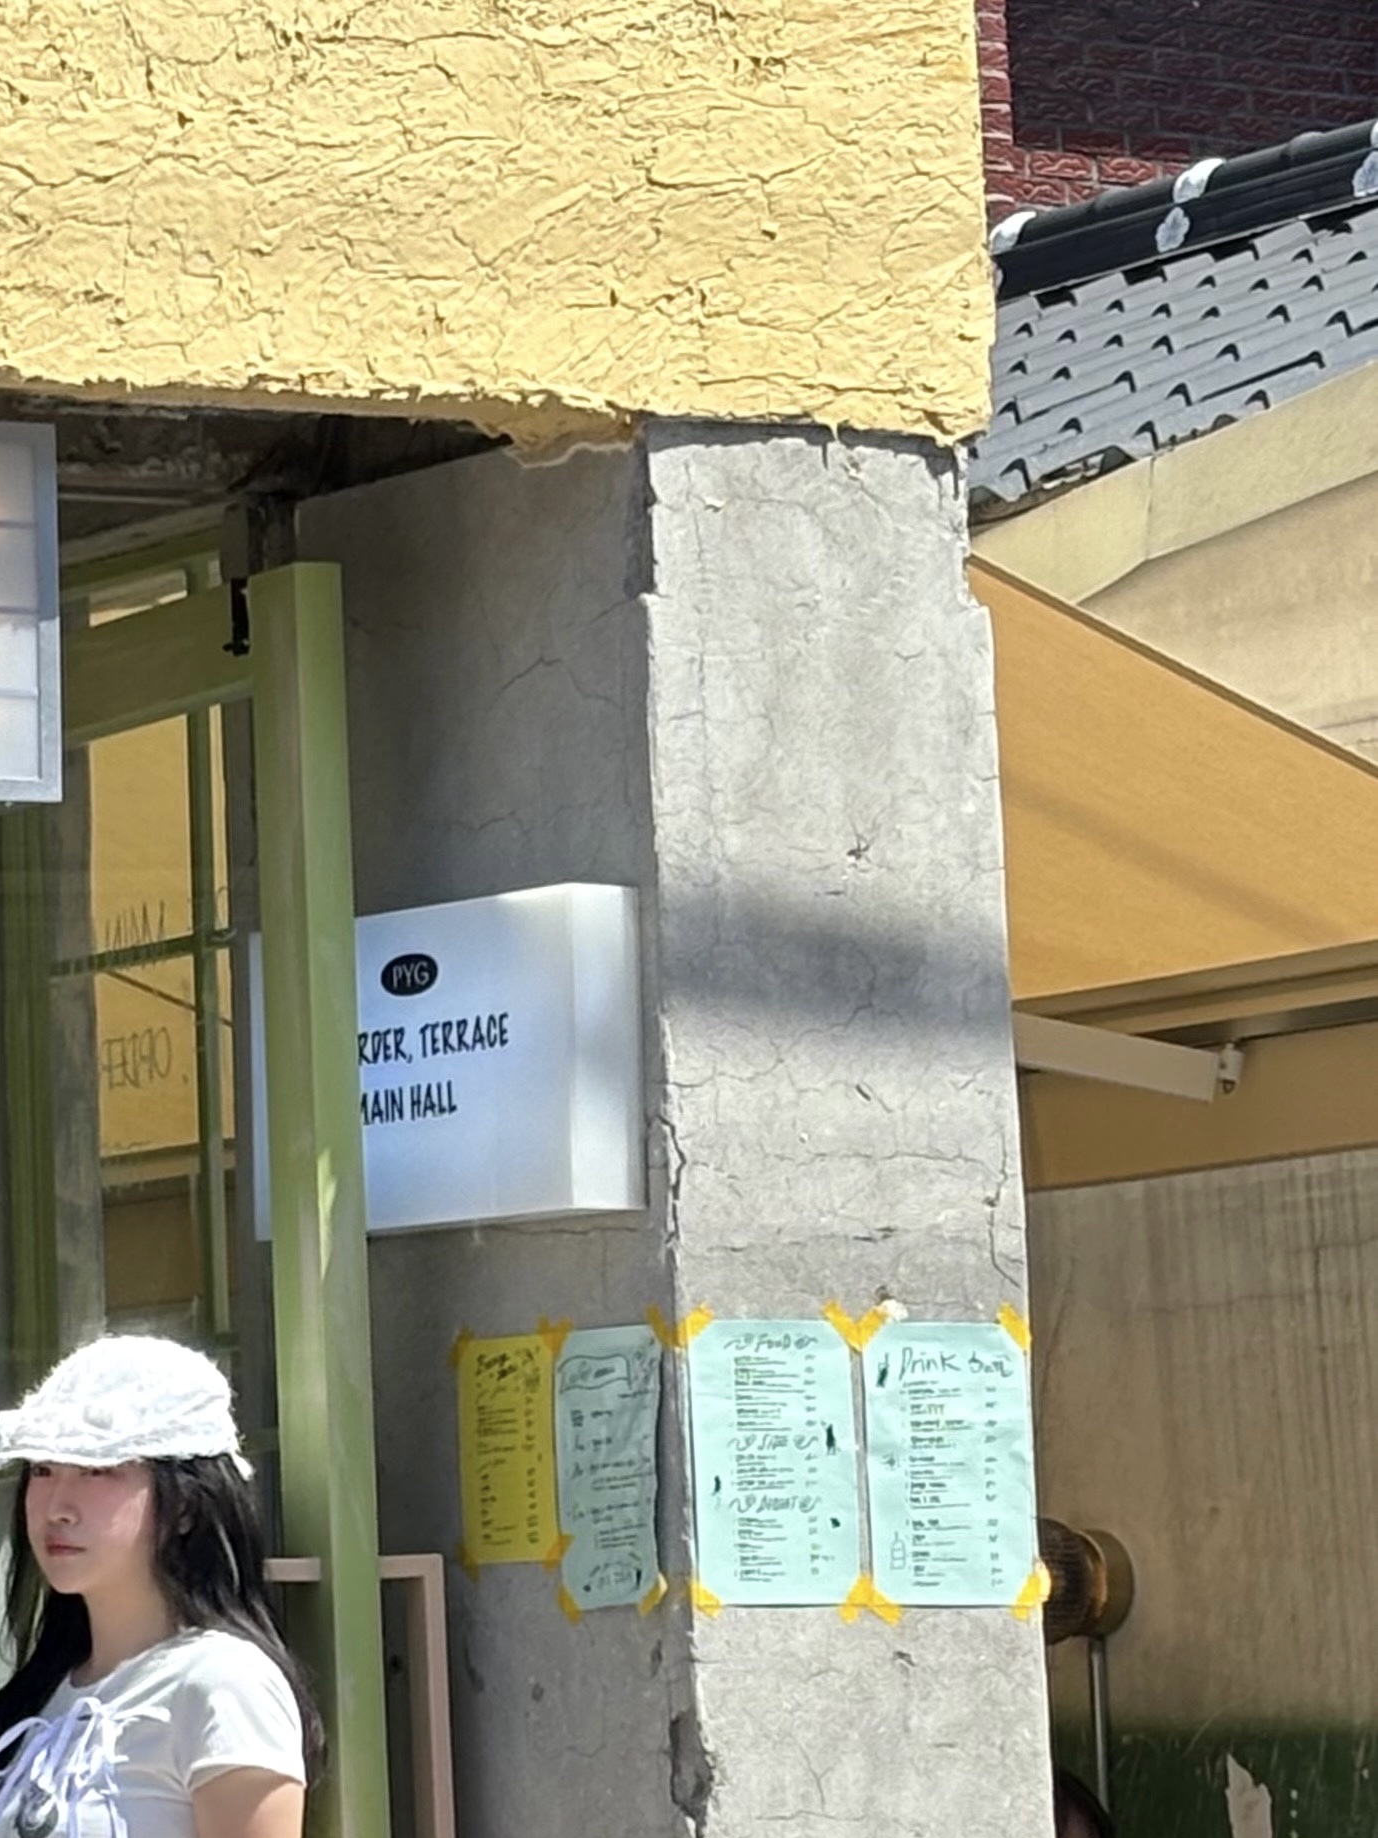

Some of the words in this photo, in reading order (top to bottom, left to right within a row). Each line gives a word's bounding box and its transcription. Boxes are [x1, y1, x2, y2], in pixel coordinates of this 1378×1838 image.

[391, 960, 430, 990] PYG
[419, 1011, 510, 1059] TERRACE
[410, 1080, 458, 1122] HALL
